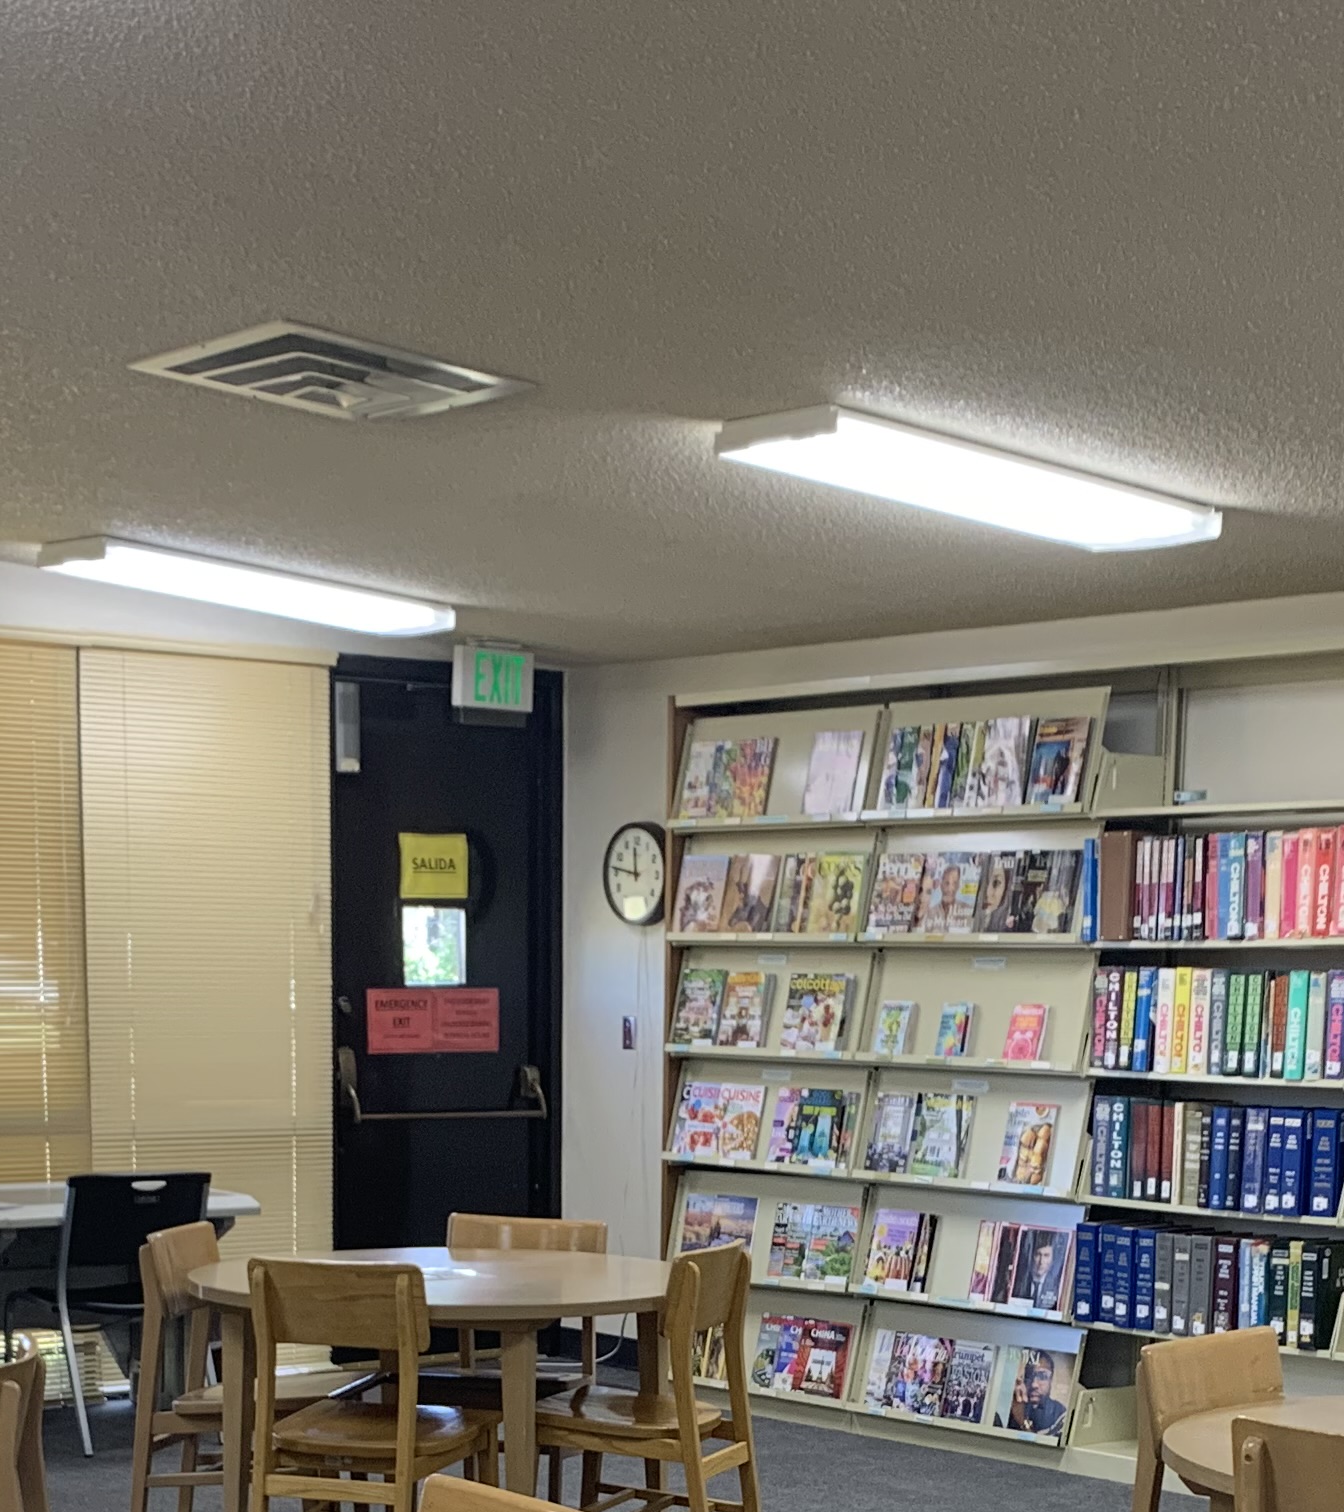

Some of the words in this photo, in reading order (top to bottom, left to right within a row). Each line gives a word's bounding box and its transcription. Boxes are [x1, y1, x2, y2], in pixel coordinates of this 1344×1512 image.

[474, 649, 524, 706] EXIT
[412, 856, 456, 872] SALIDA
[652, 854, 656, 863] 2
[655, 871, 659, 880] 3
[1230, 862, 1240, 926] CHILTON
[1316, 864, 1330, 929] CHILTON
[375, 1000, 427, 1009] EMERGENCY
[393, 1017, 410, 1026] EXIT
[1106, 972, 1120, 1038] CHILTON
[1193, 1004, 1204, 1053] CHILTO
[1211, 1001, 1223, 1052] CHILTO
[1230, 975, 1241, 1041] CHILTON
[1248, 975, 1258, 1041] CHILTON
[1287, 1007, 1301, 1070] CHILTON
[693, 1087, 720, 1098] CUISI
[722, 1087, 761, 1102] CUISINE
[1095, 1127, 1106, 1176] CHILTO
[1110, 1103, 1124, 1168] CHILTON
[811, 1328, 835, 1339] CHINA
[953, 1349, 985, 1362] rumpet
